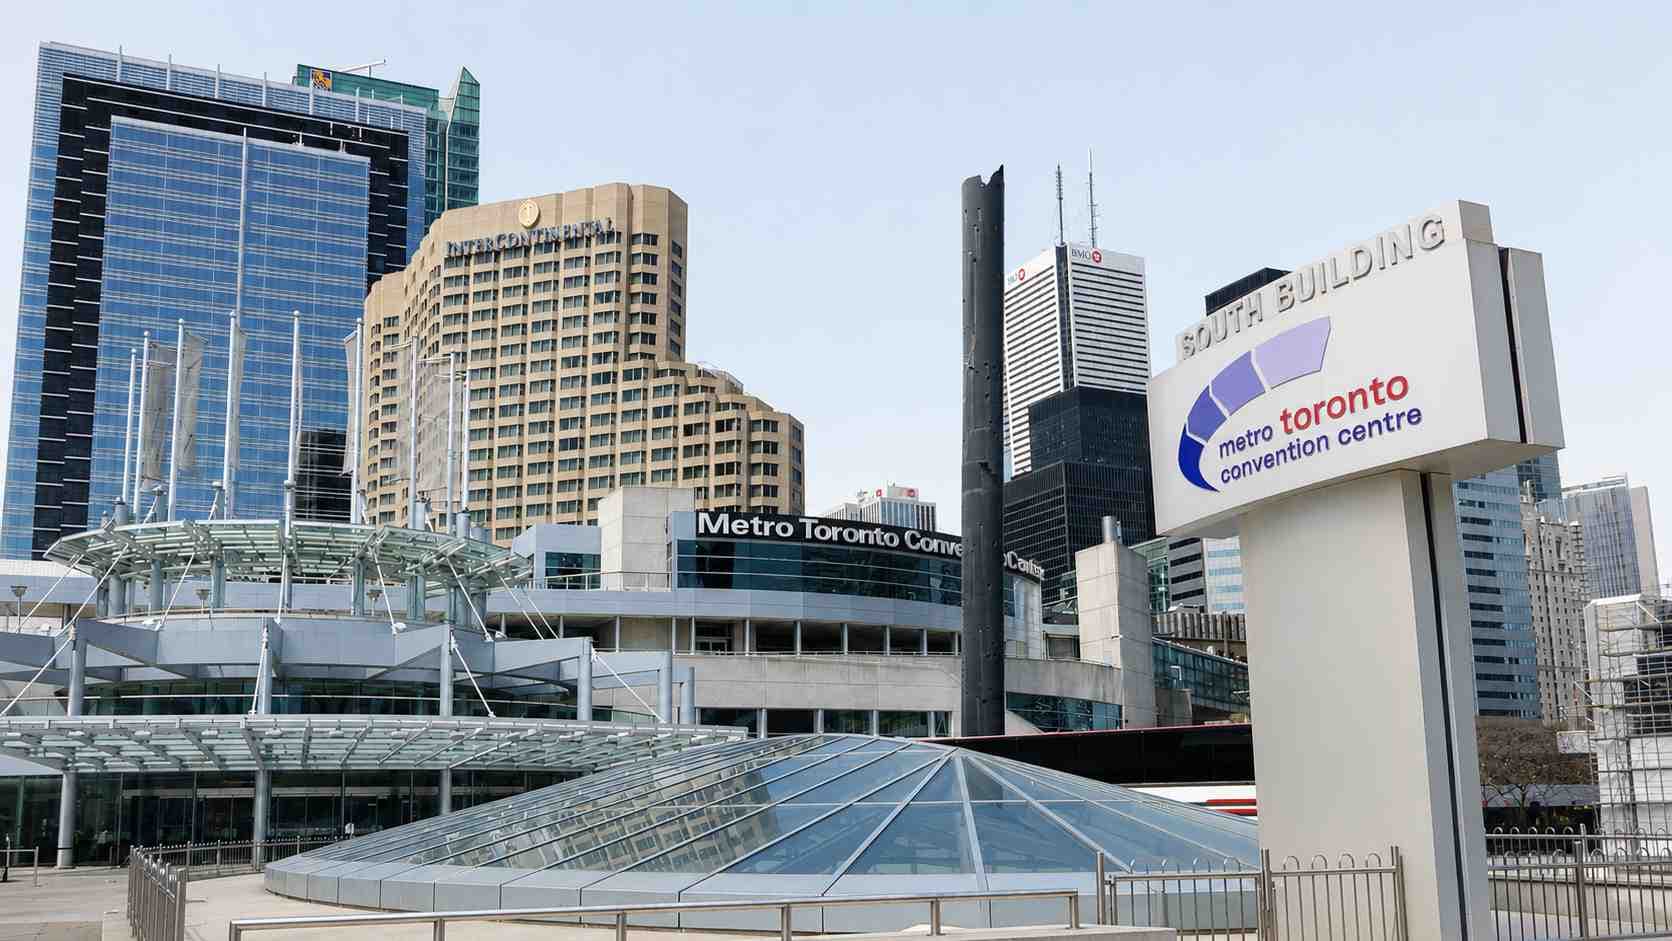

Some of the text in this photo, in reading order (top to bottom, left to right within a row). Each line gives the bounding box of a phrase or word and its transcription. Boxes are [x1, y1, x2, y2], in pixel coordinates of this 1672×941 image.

[1070, 248, 1092, 261] BMO
[1180, 214, 1446, 360] SOUTH BUILDING
[1219, 375, 1409, 459] metro toronto
[1220, 407, 1422, 484] convention centre
[698, 512, 794, 537] Metro
[799, 518, 900, 547] Toronto
